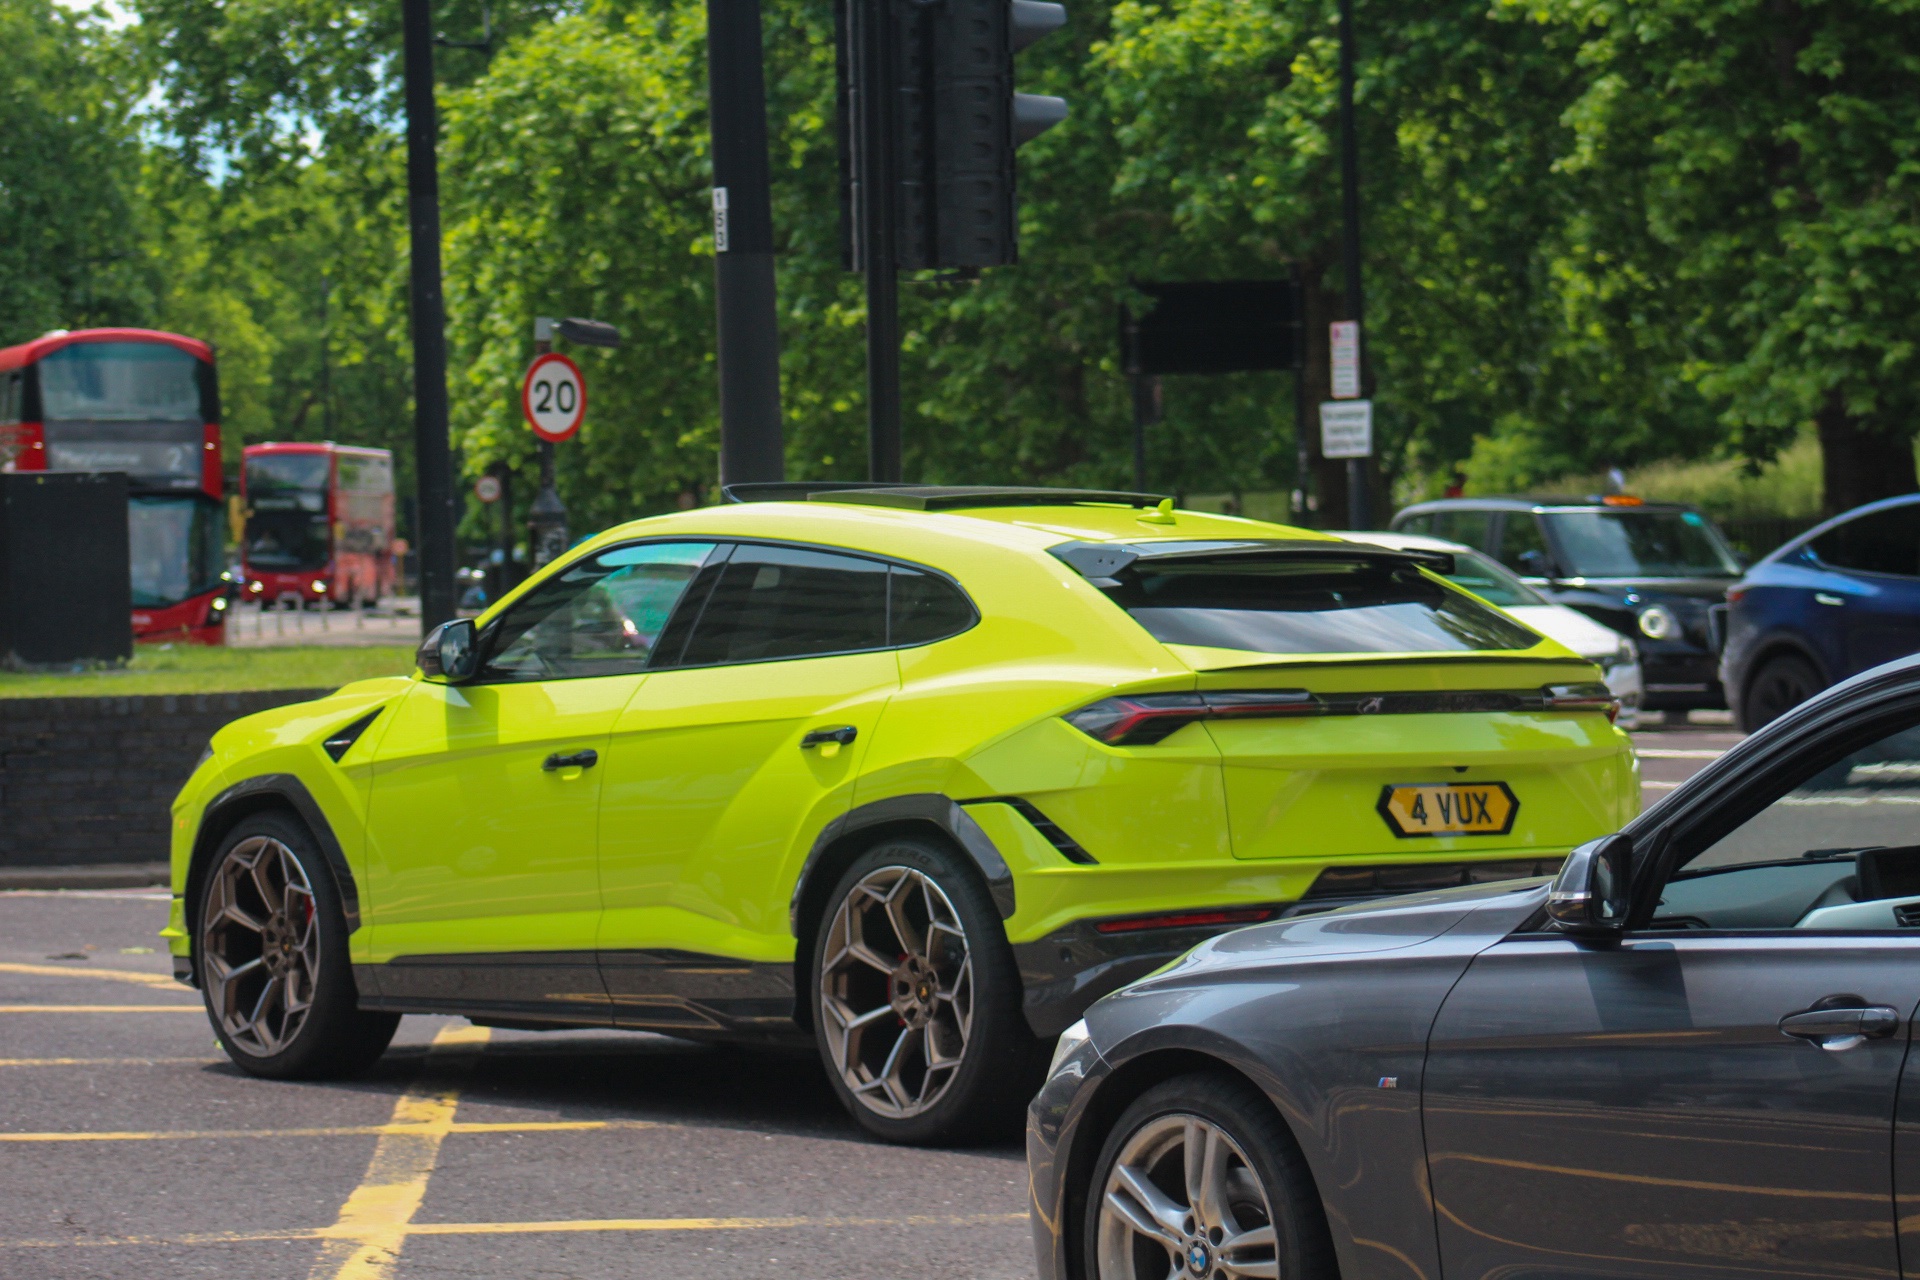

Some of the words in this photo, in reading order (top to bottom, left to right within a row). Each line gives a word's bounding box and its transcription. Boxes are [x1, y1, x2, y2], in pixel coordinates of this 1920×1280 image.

[534, 381, 575, 413] 20
[1412, 793, 1427, 825] 4
[1435, 792, 1492, 824] VUX
